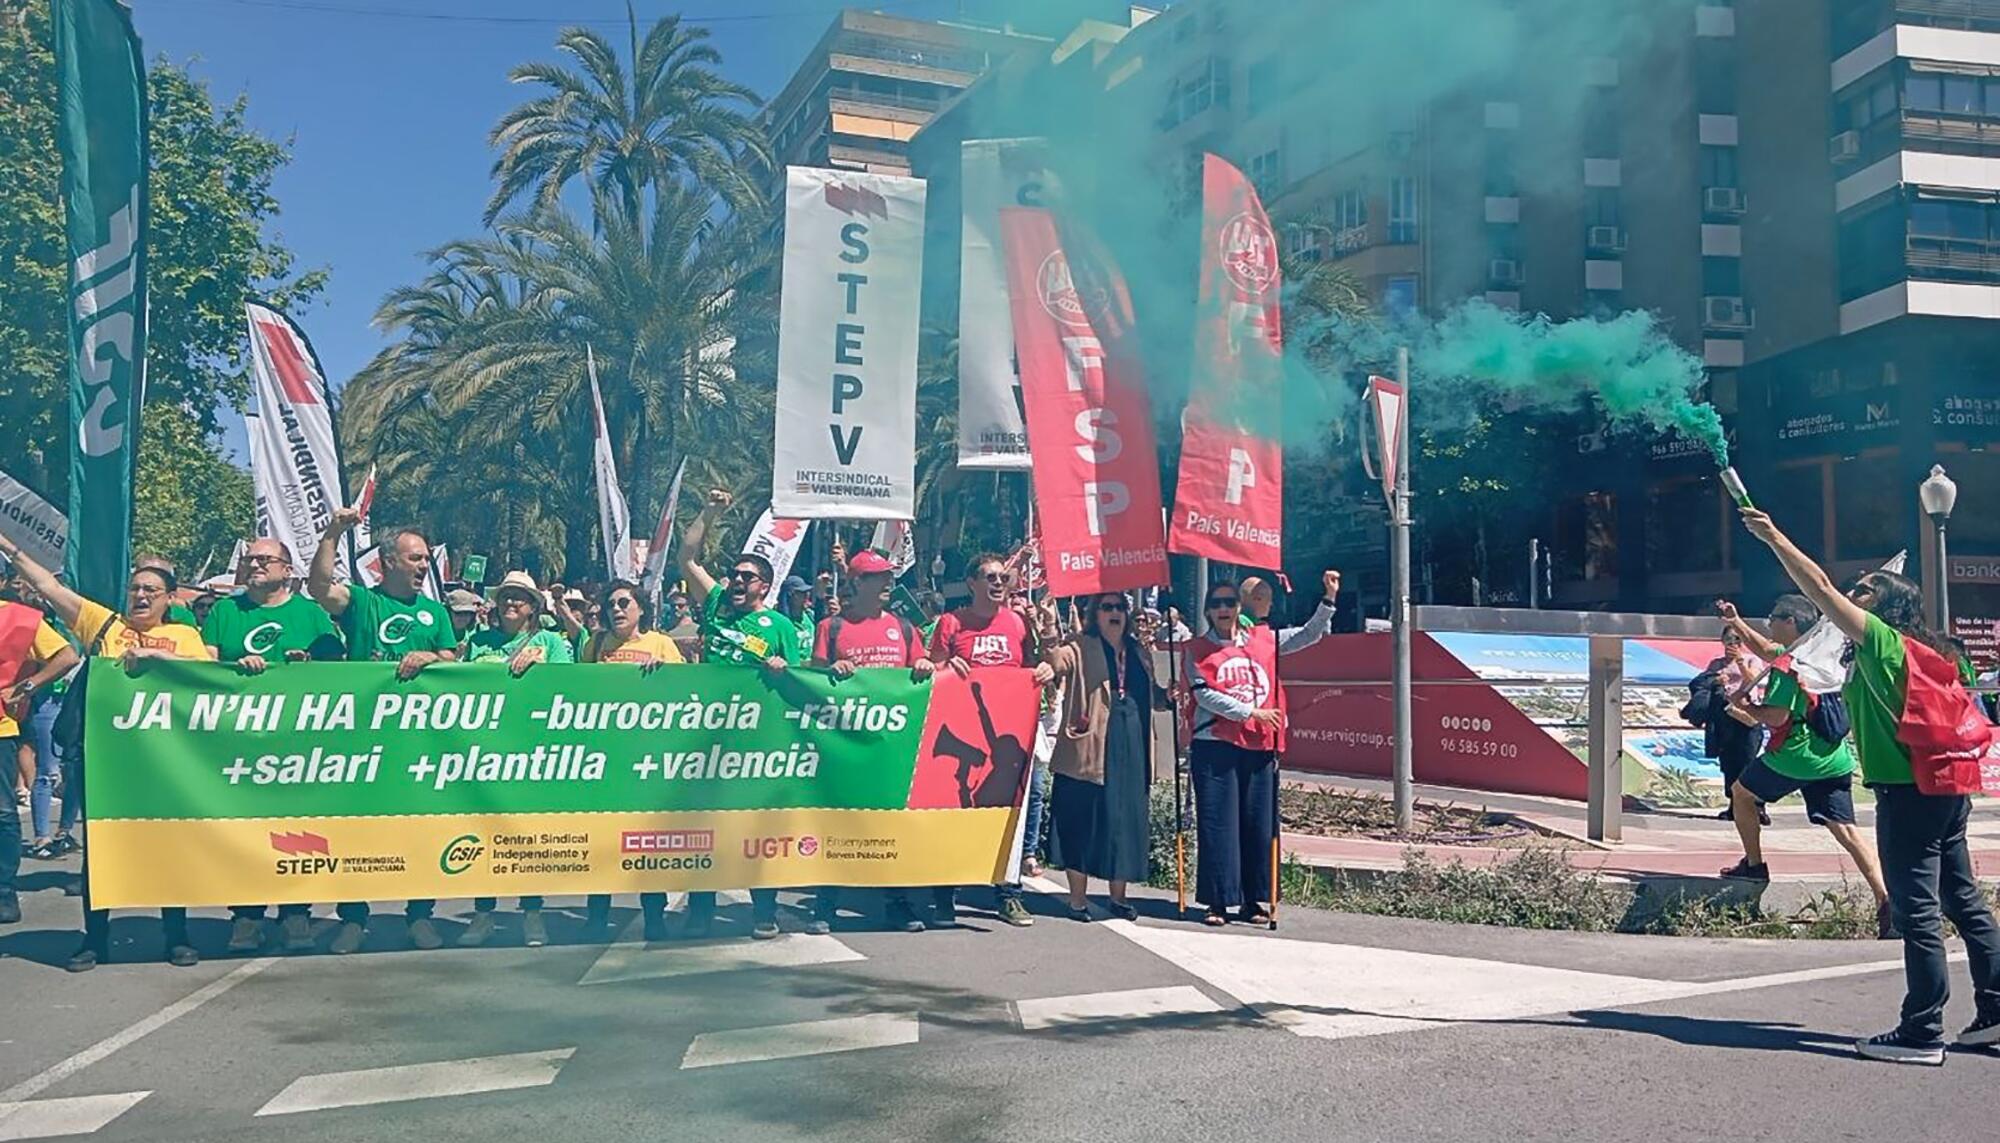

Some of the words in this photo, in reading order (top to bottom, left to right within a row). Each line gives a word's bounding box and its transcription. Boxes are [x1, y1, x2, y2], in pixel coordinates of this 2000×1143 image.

[796, 470, 892, 486] INTERSINDICAL
[810, 483, 891, 498] VALENCIANA
[973, 635, 1009, 653] UGT
[113, 691, 172, 731] JA
[295, 693, 355, 731] HA
[369, 692, 505, 731] PROU!
[530, 692, 762, 731] -burocràcia
[784, 695, 908, 732] -ràtios
[1440, 737, 1456, 752] 96
[1458, 738, 1480, 755] 585
[1481, 741, 1498, 756] 59
[1500, 743, 1518, 758] 00
[221, 744, 384, 785] +salari
[407, 745, 607, 790] +plantilla
[632, 743, 820, 781] +valencià
[493, 833, 537, 846] Central
[540, 833, 589, 845] Sindical
[625, 834, 687, 850] CCOO
[743, 836, 794, 859] UGT
[493, 847, 579, 862] Independiente
[581, 849, 590, 862] y
[621, 854, 713, 871] educació
[276, 857, 339, 875] STEPV
[352, 864, 406, 873] VALENCIANA
[492, 862, 508, 874] de
[511, 861, 591, 874] Funcionarios
